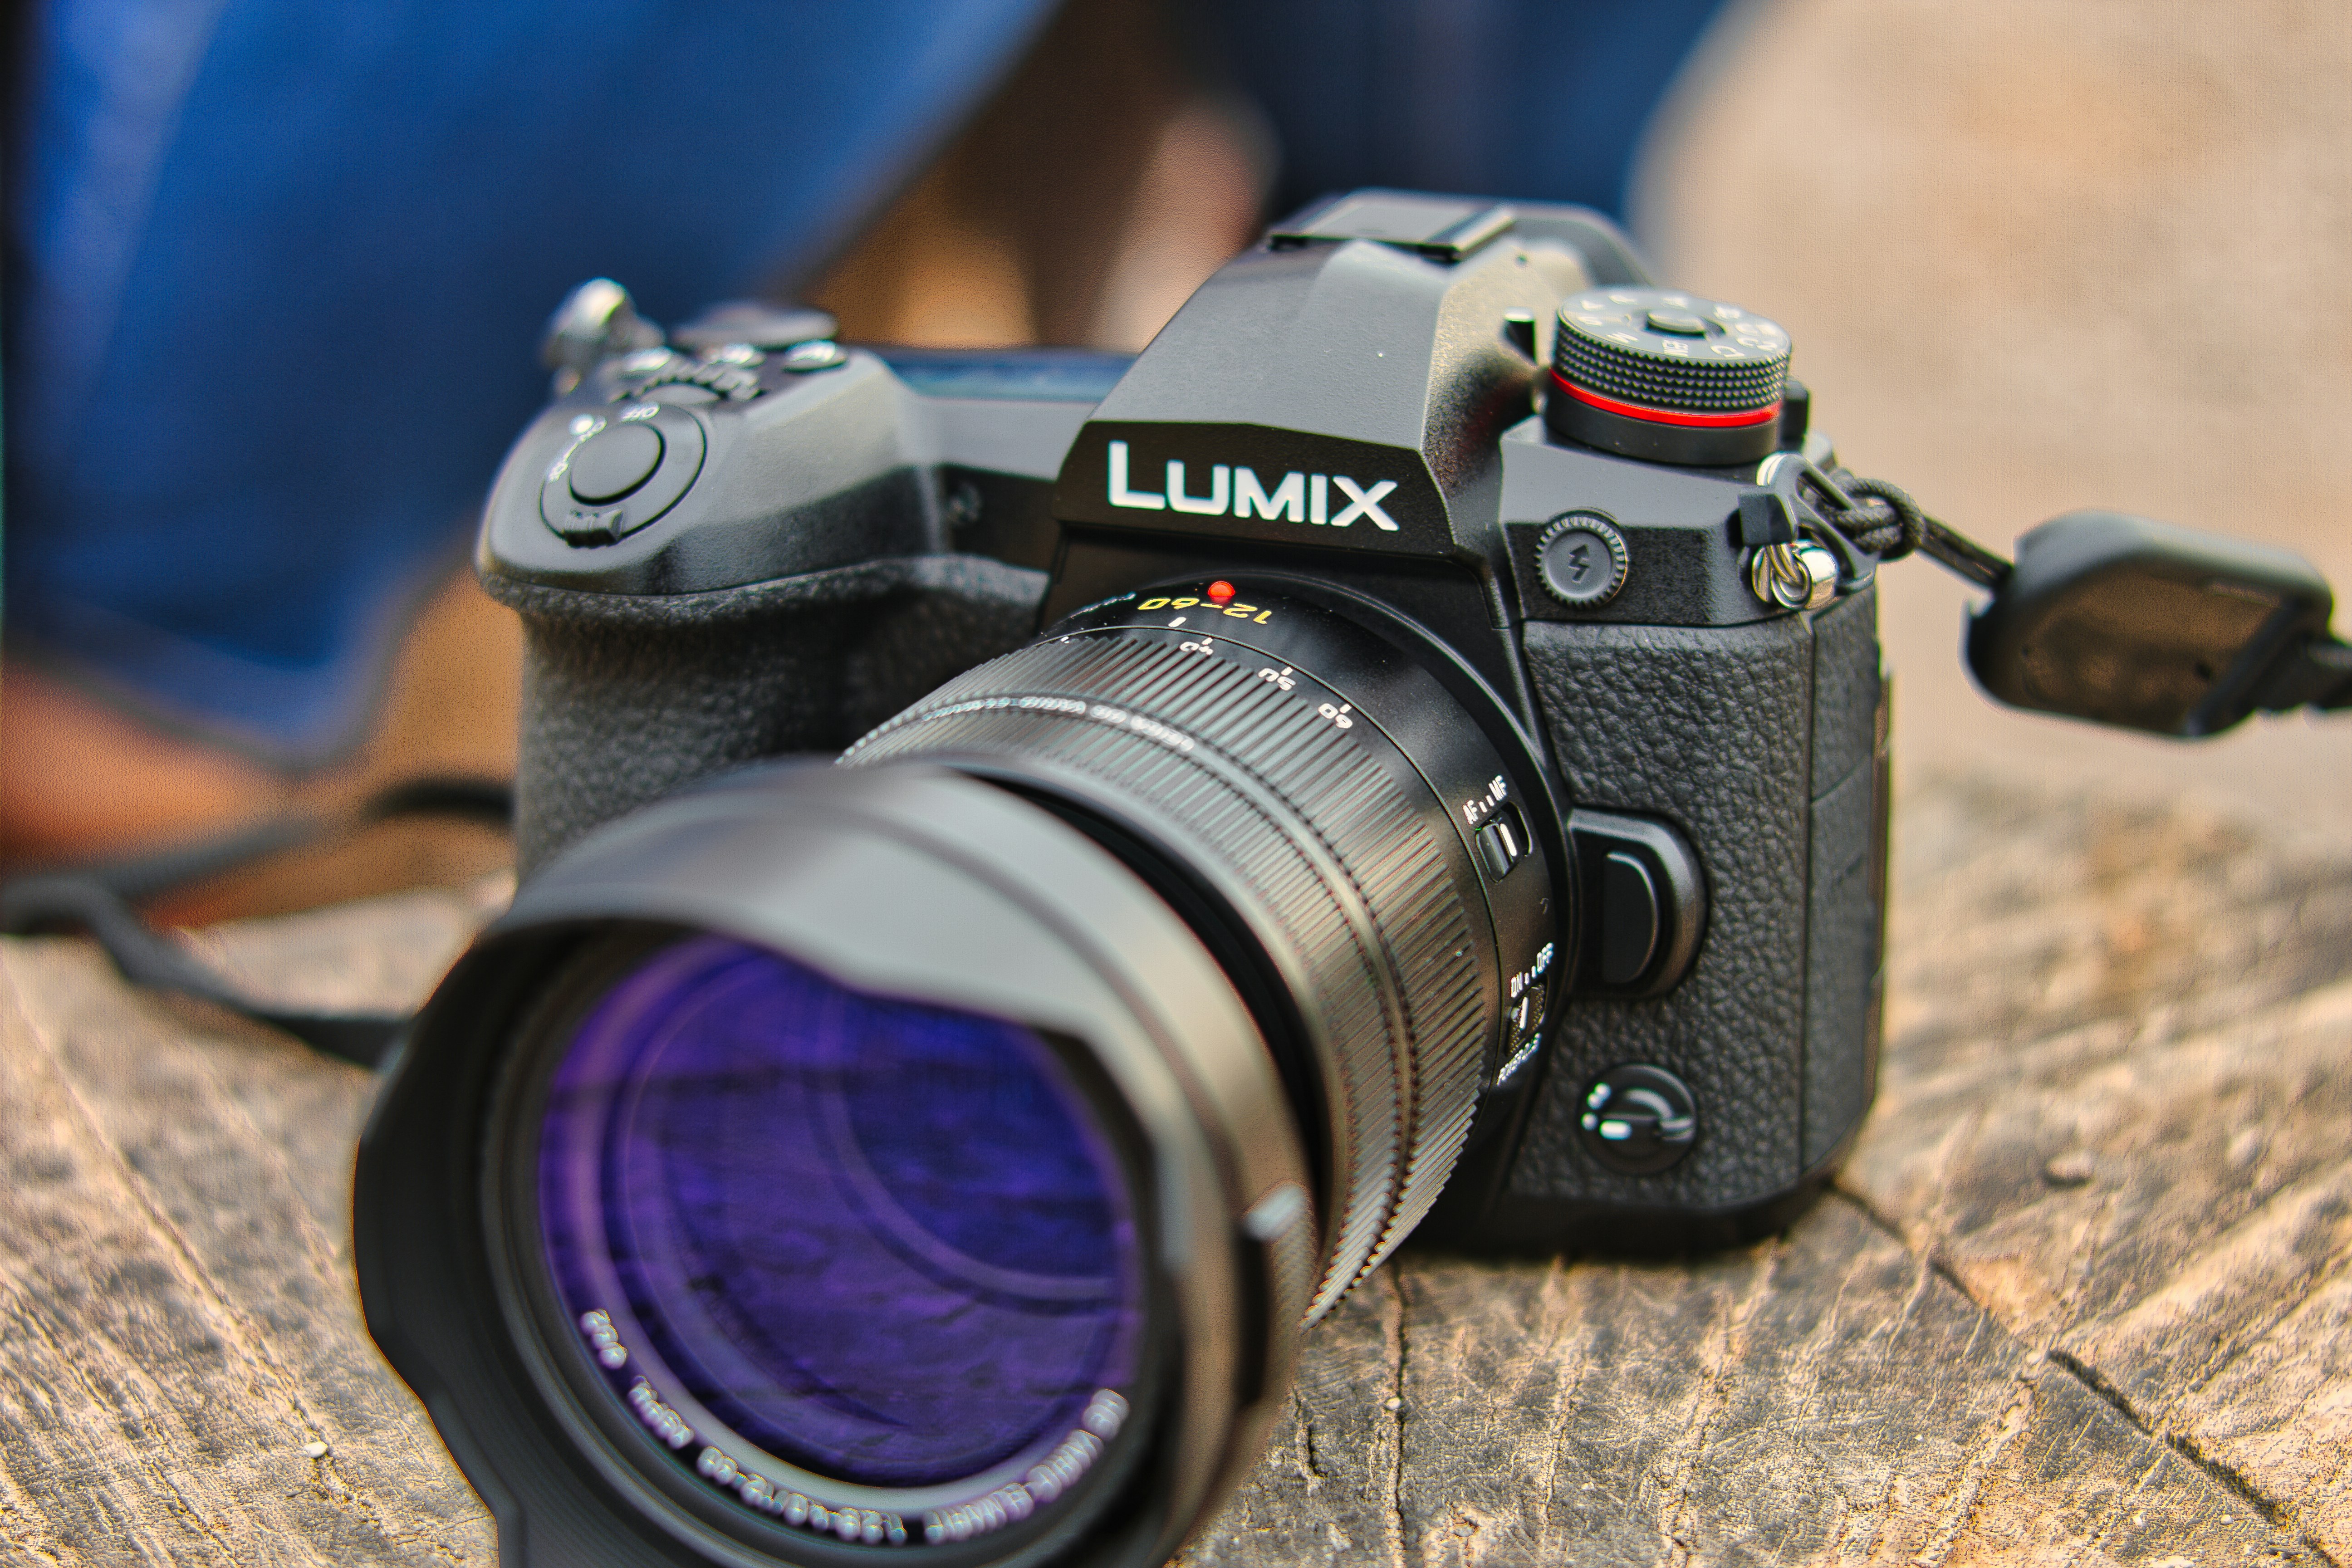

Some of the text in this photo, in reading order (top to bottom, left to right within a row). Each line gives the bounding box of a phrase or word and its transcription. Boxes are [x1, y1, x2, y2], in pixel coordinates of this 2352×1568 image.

[1108, 440, 1399, 531] LUMIX
[1137, 598, 1273, 625] 12-60
[1258, 667, 1296, 691] 50
[1318, 703, 1353, 729] 60
[1462, 775, 1508, 825] AF MF
[1510, 942, 1554, 999] ON OFF
